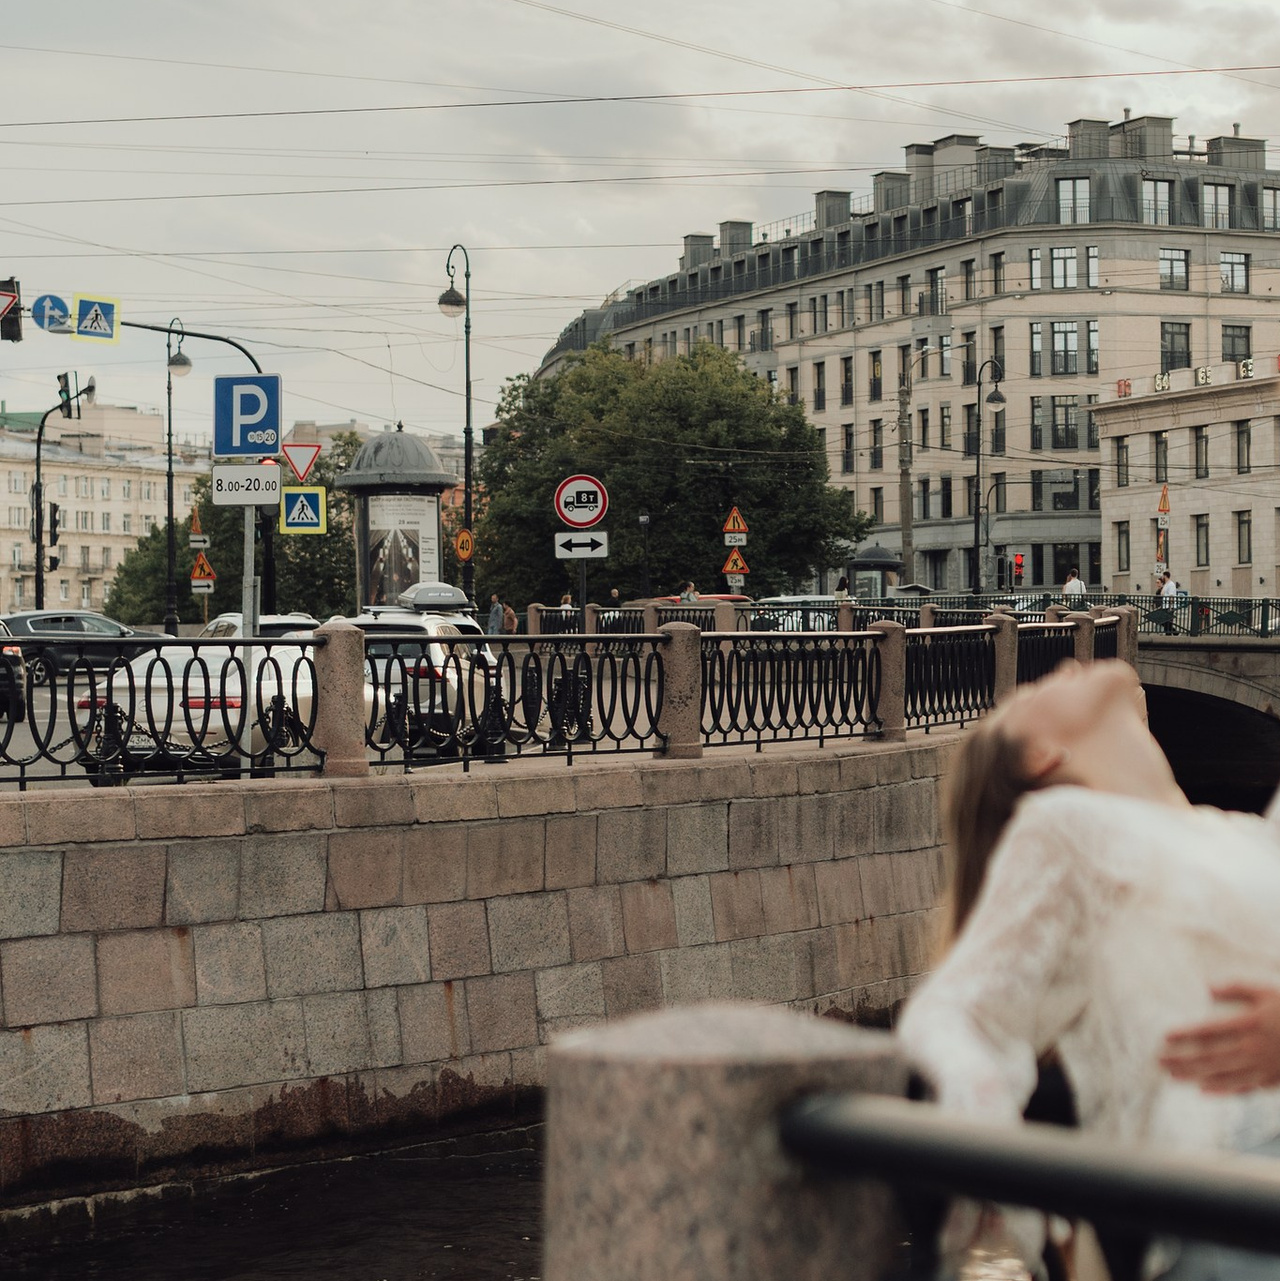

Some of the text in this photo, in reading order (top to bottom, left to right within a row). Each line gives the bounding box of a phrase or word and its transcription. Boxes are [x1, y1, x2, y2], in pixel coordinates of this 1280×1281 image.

[232, 384, 268, 447] P
[265, 432, 276, 442] 20
[215, 478, 277, 492] 8.00-20.00
[459, 539, 470, 552] 40
